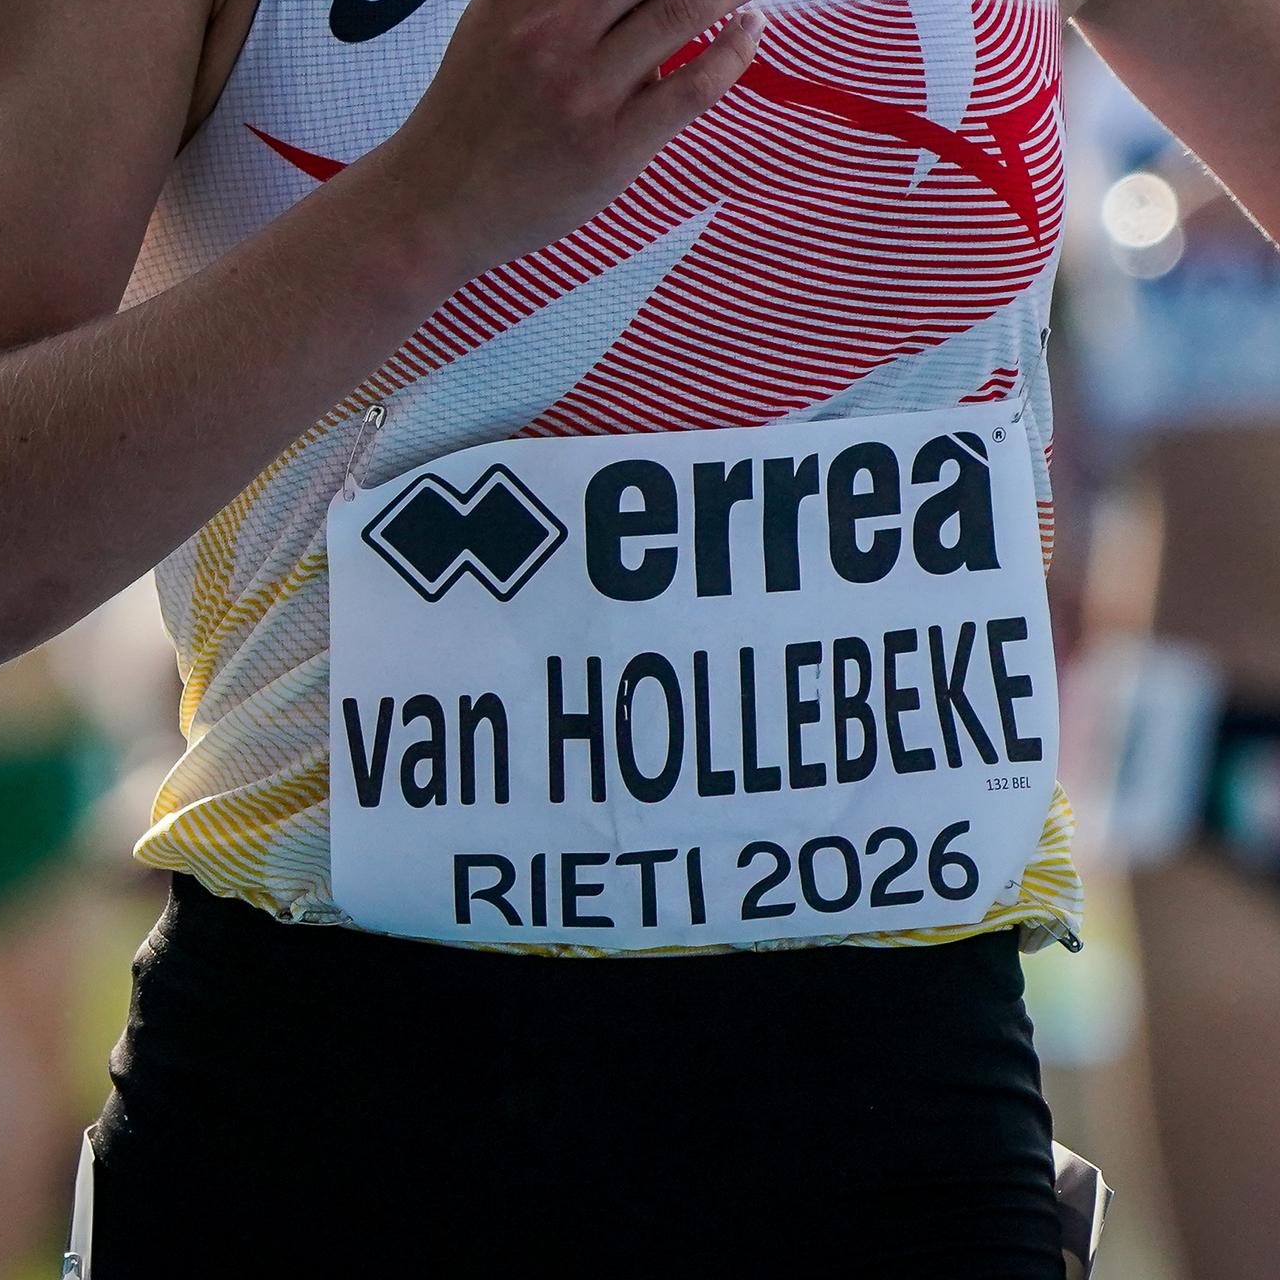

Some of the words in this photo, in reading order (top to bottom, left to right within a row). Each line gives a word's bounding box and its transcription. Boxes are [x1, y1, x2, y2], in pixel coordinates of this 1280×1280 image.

[341, 692, 510, 809] van
[546, 616, 1043, 804] HOLLEBEKE
[985, 777, 1009, 791] 132
[1011, 776, 1031, 789] BEL
[453, 846, 707, 929] RIETI
[736, 819, 980, 921] 2026
